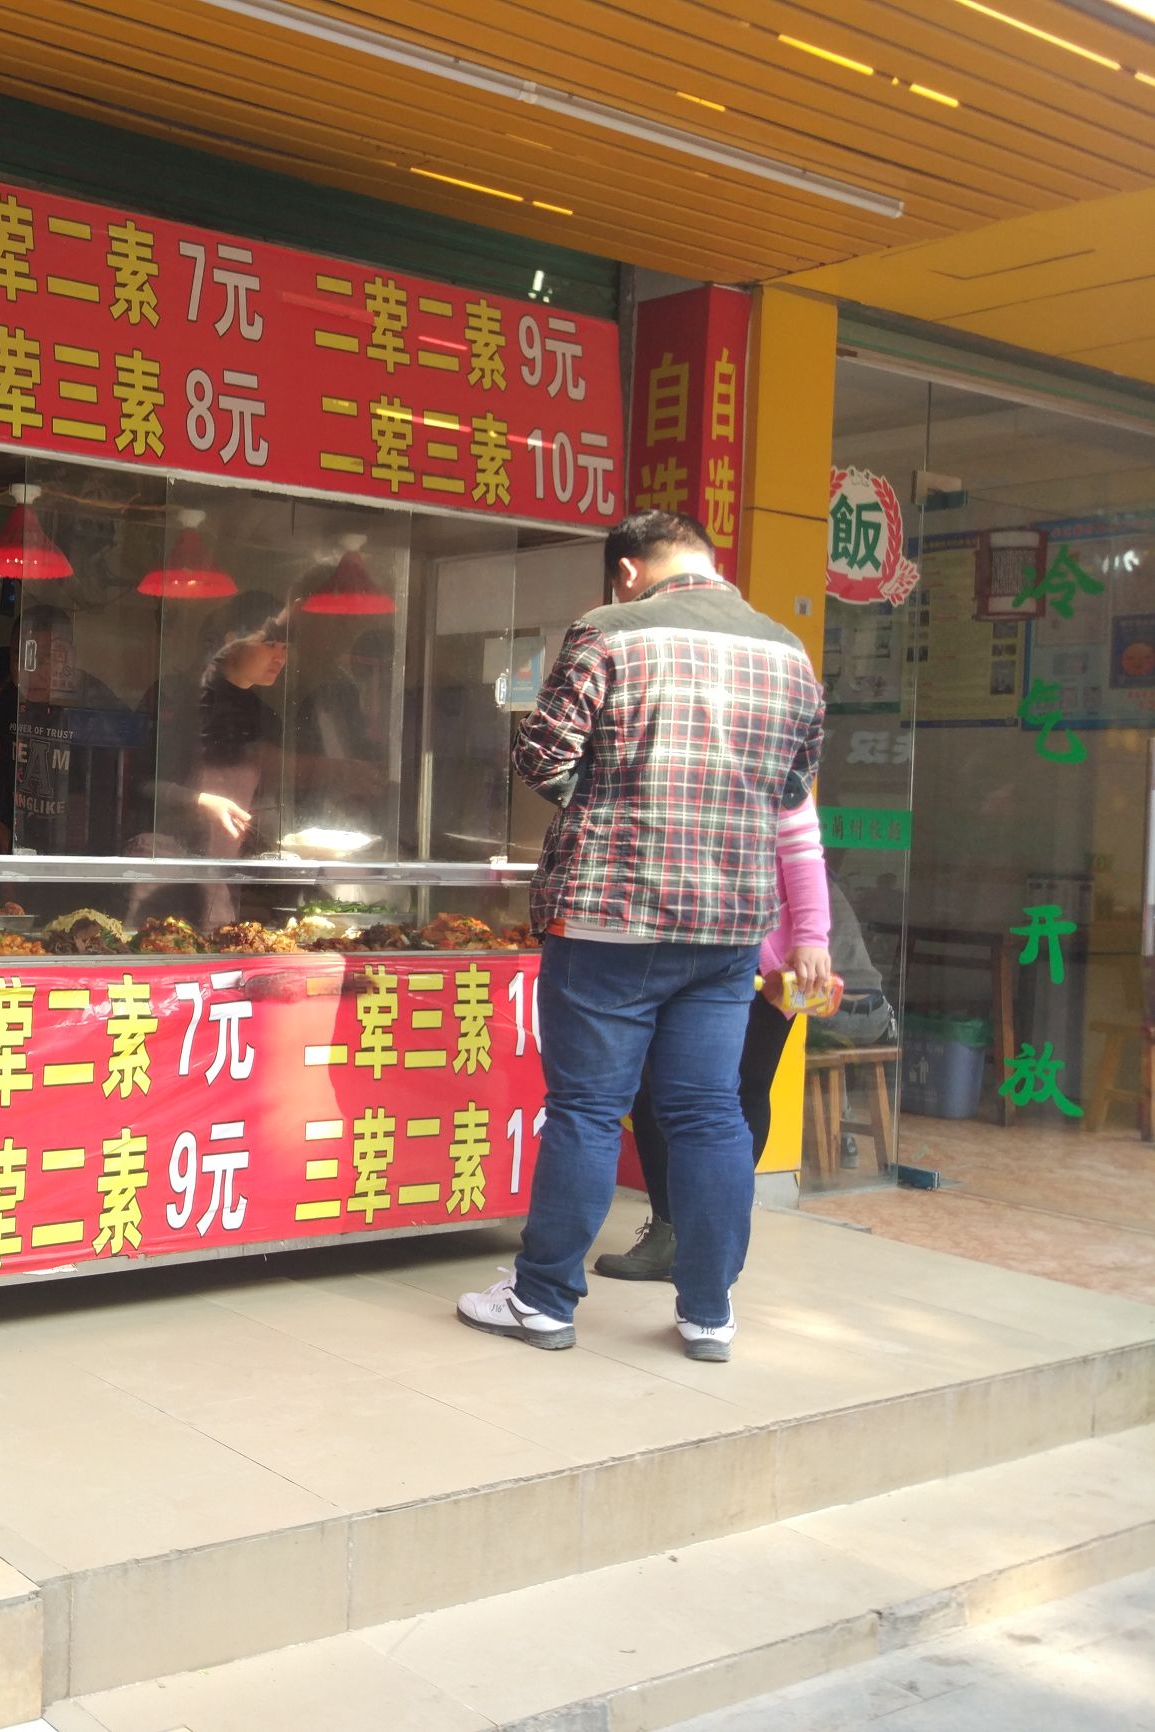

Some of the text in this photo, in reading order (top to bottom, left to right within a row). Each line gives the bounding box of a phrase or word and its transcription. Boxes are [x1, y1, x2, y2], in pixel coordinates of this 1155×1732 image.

[705, 347, 737, 580] 自选
[829, 493, 885, 573] 飯
[46, 727, 74, 740] TRUST
